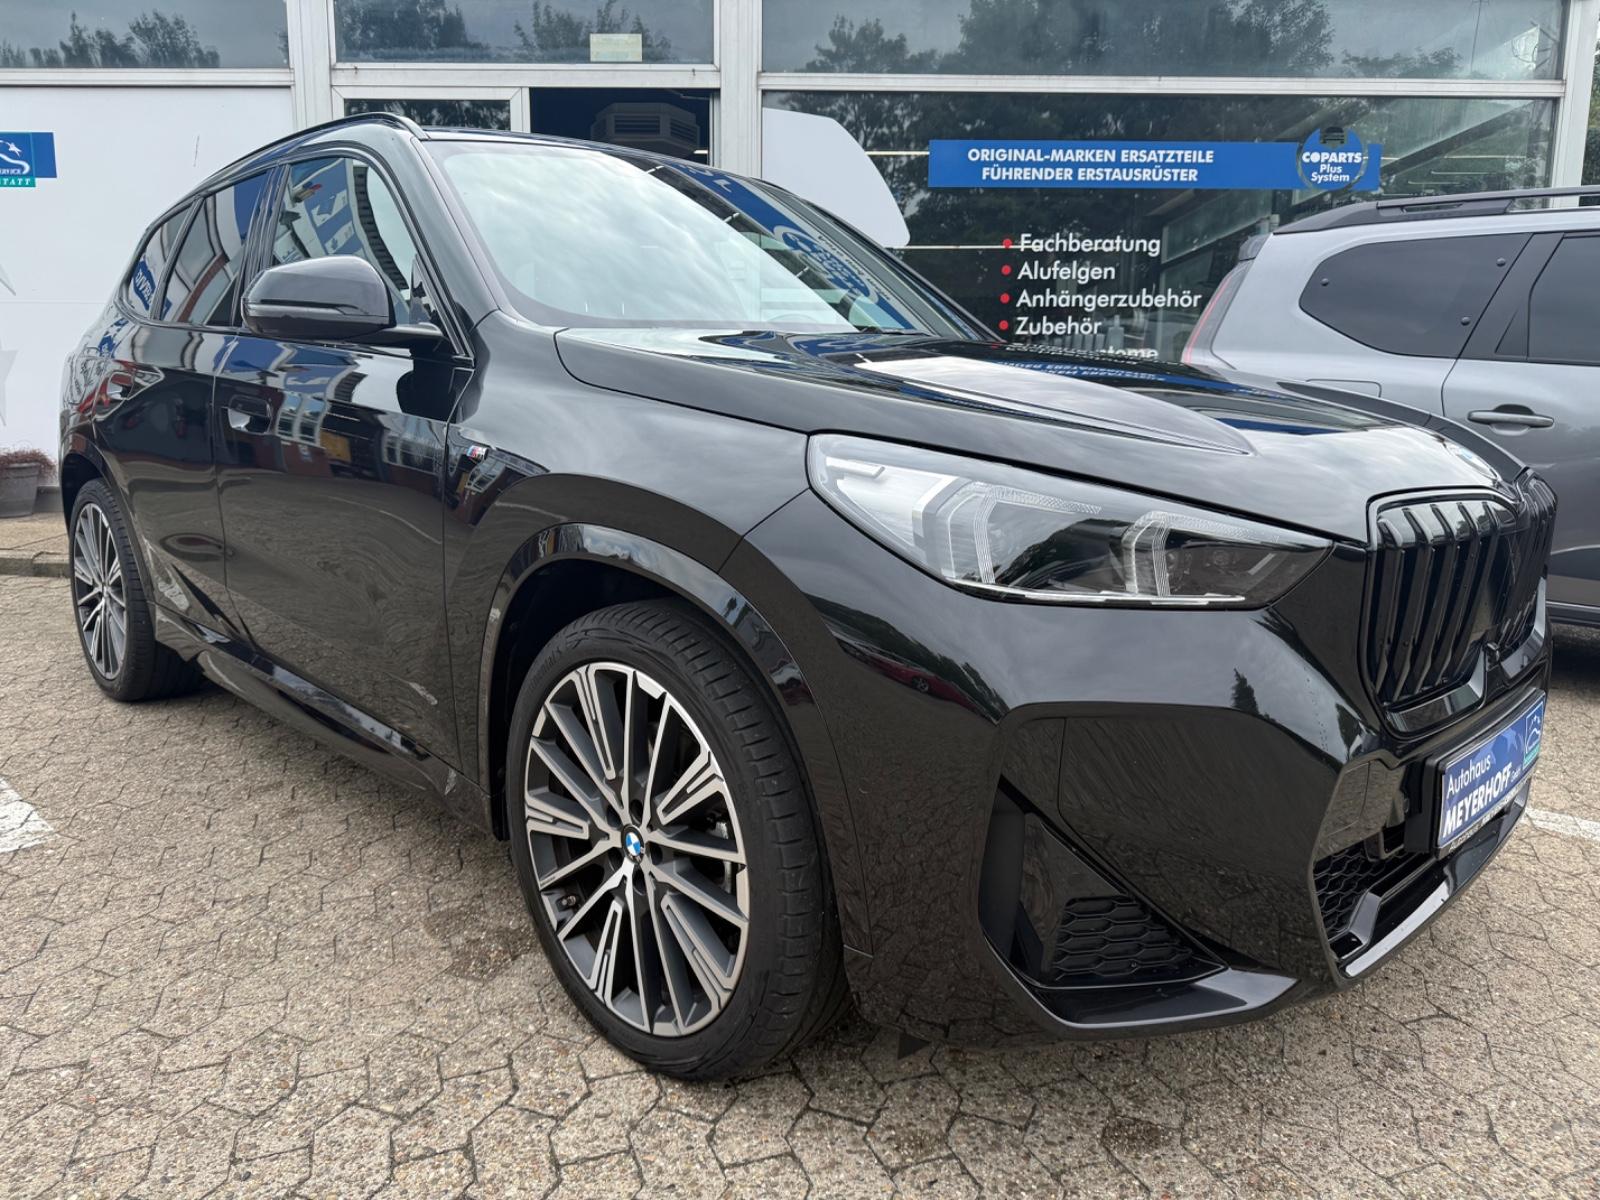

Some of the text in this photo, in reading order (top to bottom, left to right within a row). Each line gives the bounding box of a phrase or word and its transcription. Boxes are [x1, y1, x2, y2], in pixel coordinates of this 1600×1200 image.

[967, 148, 1214, 163] ORIGINAL-MARKEN ERSATZTEILE
[1302, 151, 1362, 163] COPARTS
[981, 163, 1199, 182] FÜHRENDER ERSTAUSRÜSTER
[1311, 171, 1350, 184] System
[1320, 163, 1343, 174] Plus
[0, 177, 31, 186] TATT
[1020, 232, 1161, 257] Fachberatung
[1017, 260, 1116, 285] Alufelgen
[1015, 287, 1202, 312] Anhängerzubehör
[1015, 315, 1102, 335] Zubehör
[1447, 755, 1491, 799] Autohaus
[1442, 762, 1512, 838] MEYERHOFF
